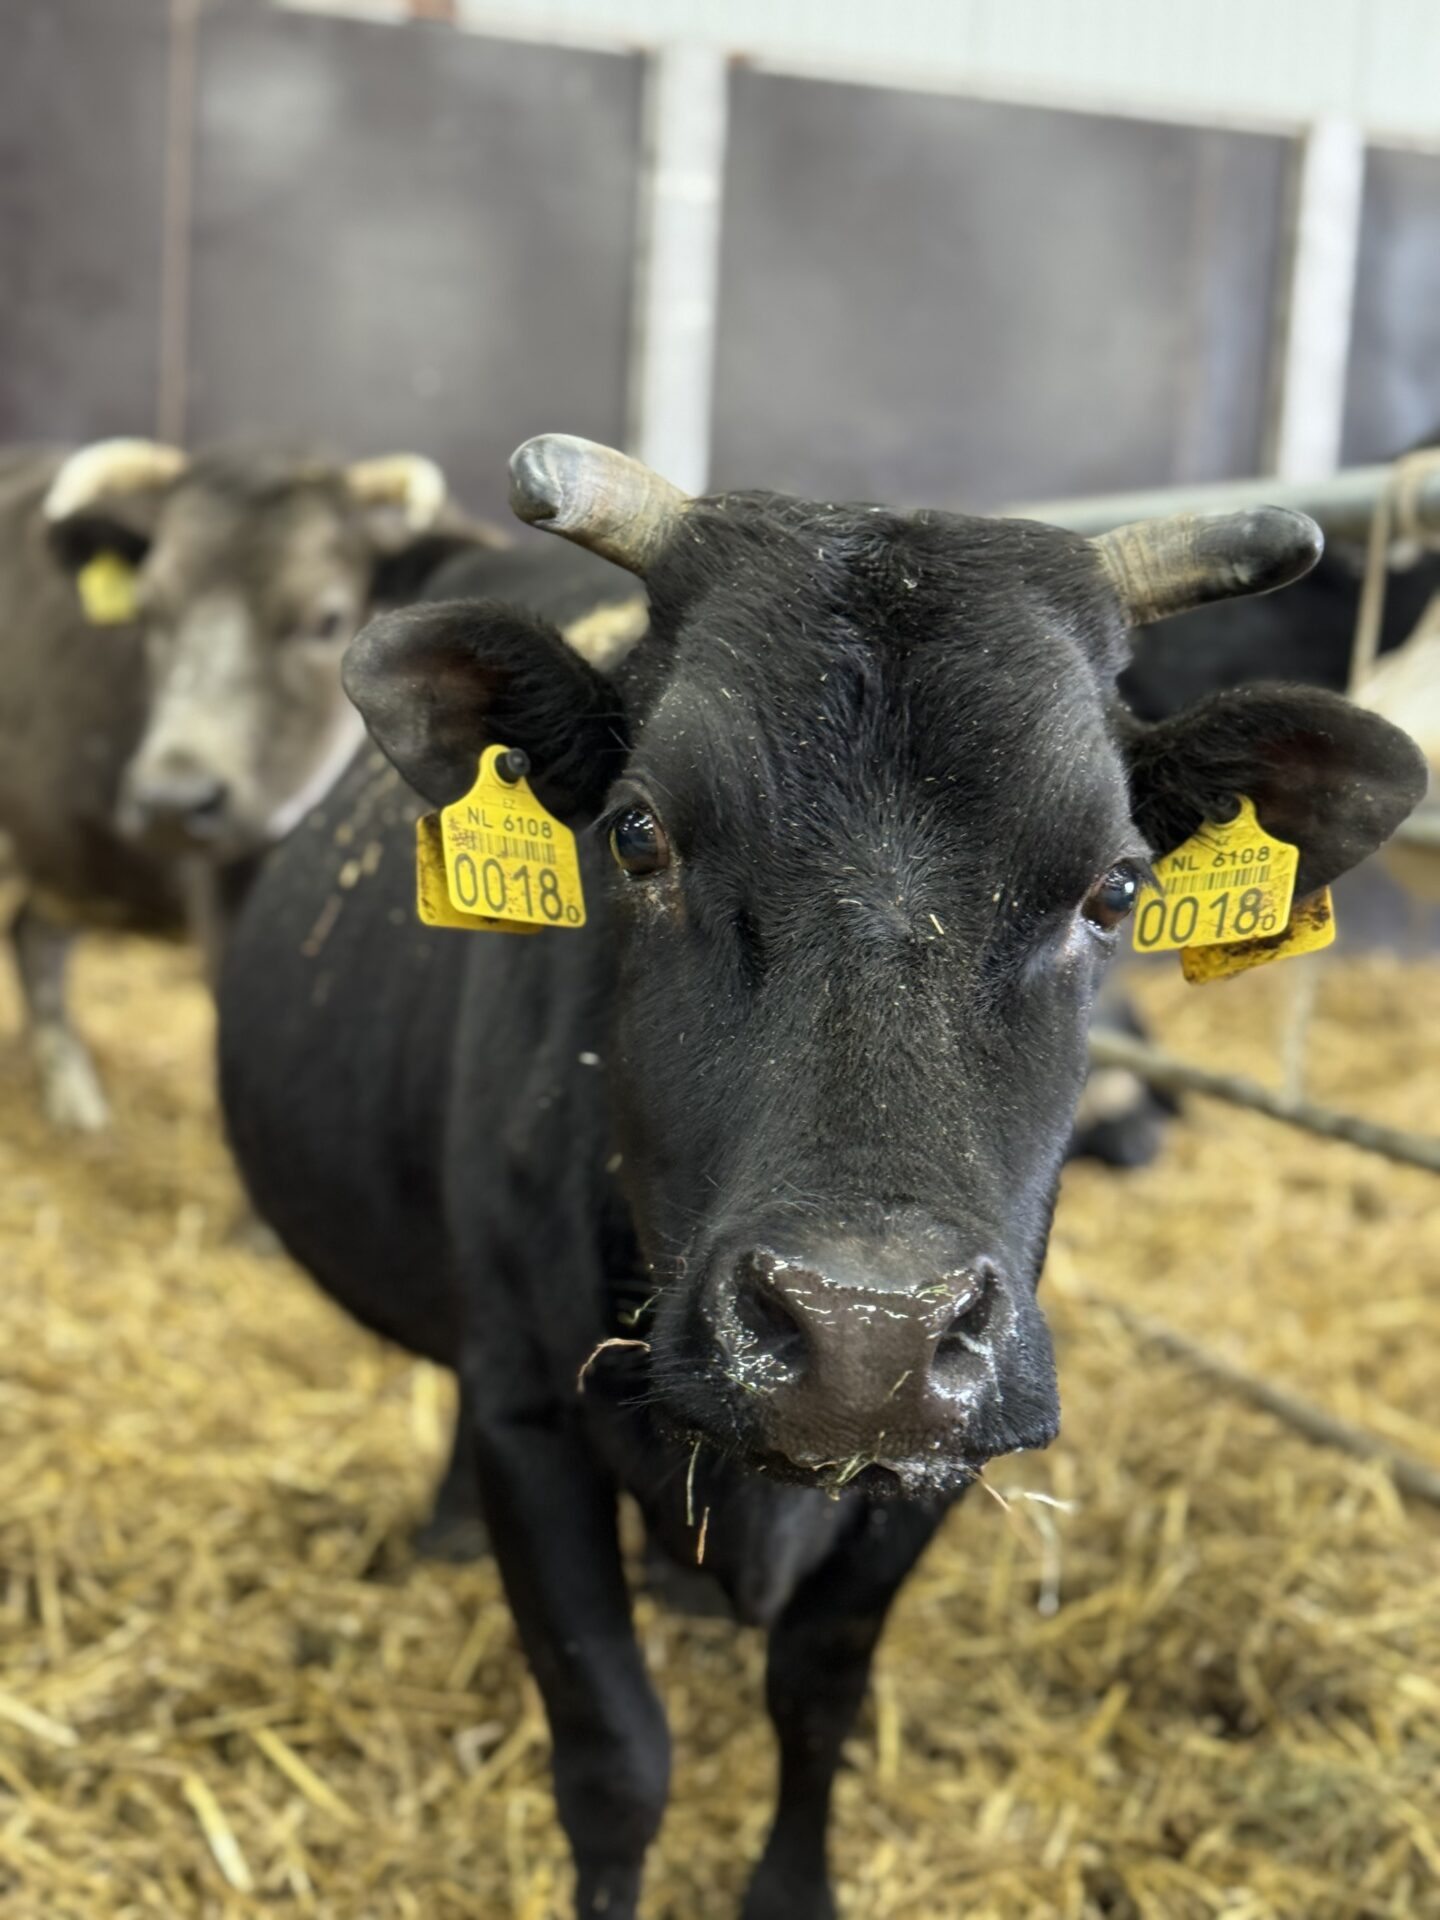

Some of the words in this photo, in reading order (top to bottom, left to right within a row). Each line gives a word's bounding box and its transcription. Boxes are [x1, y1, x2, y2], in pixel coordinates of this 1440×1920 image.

[467, 805, 494, 829] NL
[503, 814, 553, 840] 6108
[1170, 855, 1200, 873] NL
[1211, 845, 1271, 868] 6108
[454, 852, 563, 922] 0018
[1137, 887, 1264, 947] 0018
